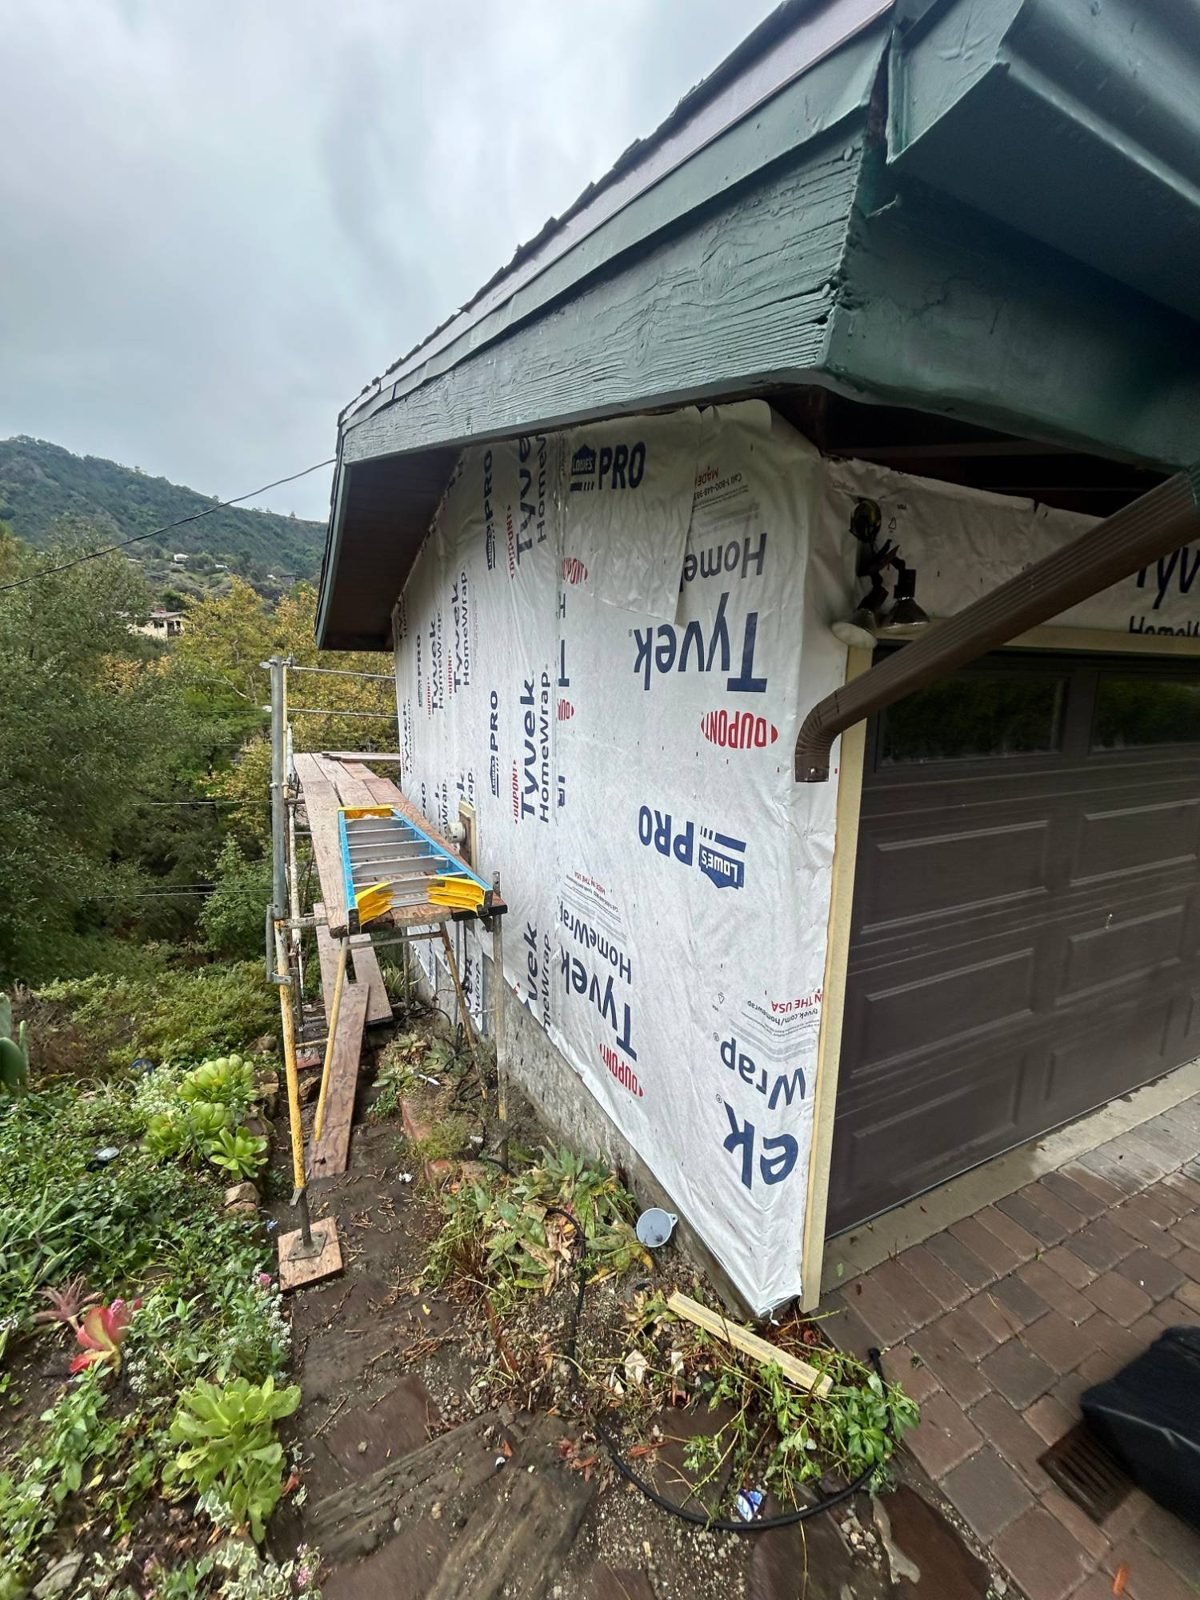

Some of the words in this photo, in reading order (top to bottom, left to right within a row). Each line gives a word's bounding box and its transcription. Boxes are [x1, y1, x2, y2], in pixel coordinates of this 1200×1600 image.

[483, 450, 493, 521] PRO
[598, 441, 646, 490] PRO
[506, 514, 516, 571] DUPONT
[680, 533, 767, 592] Home
[452, 582, 463, 693] Tyvek
[461, 572, 469, 686] HomeWrap
[633, 592, 768, 693] Tyvek
[429, 621, 439, 714] Tyvek
[489, 690, 498, 751] PRO
[520, 678, 540, 820] Tyvek
[540, 672, 551, 823] HomeWrap
[704, 709, 767, 749] DUPONT
[638, 805, 694, 867] PRO
[701, 850, 738, 883] LOWE'S
[561, 946, 638, 1062] Tyvek
[771, 1000, 793, 1014] USA
[795, 998, 814, 1009] THE
[602, 1044, 638, 1095] DUPONT
[720, 1037, 806, 1110] Wrap
